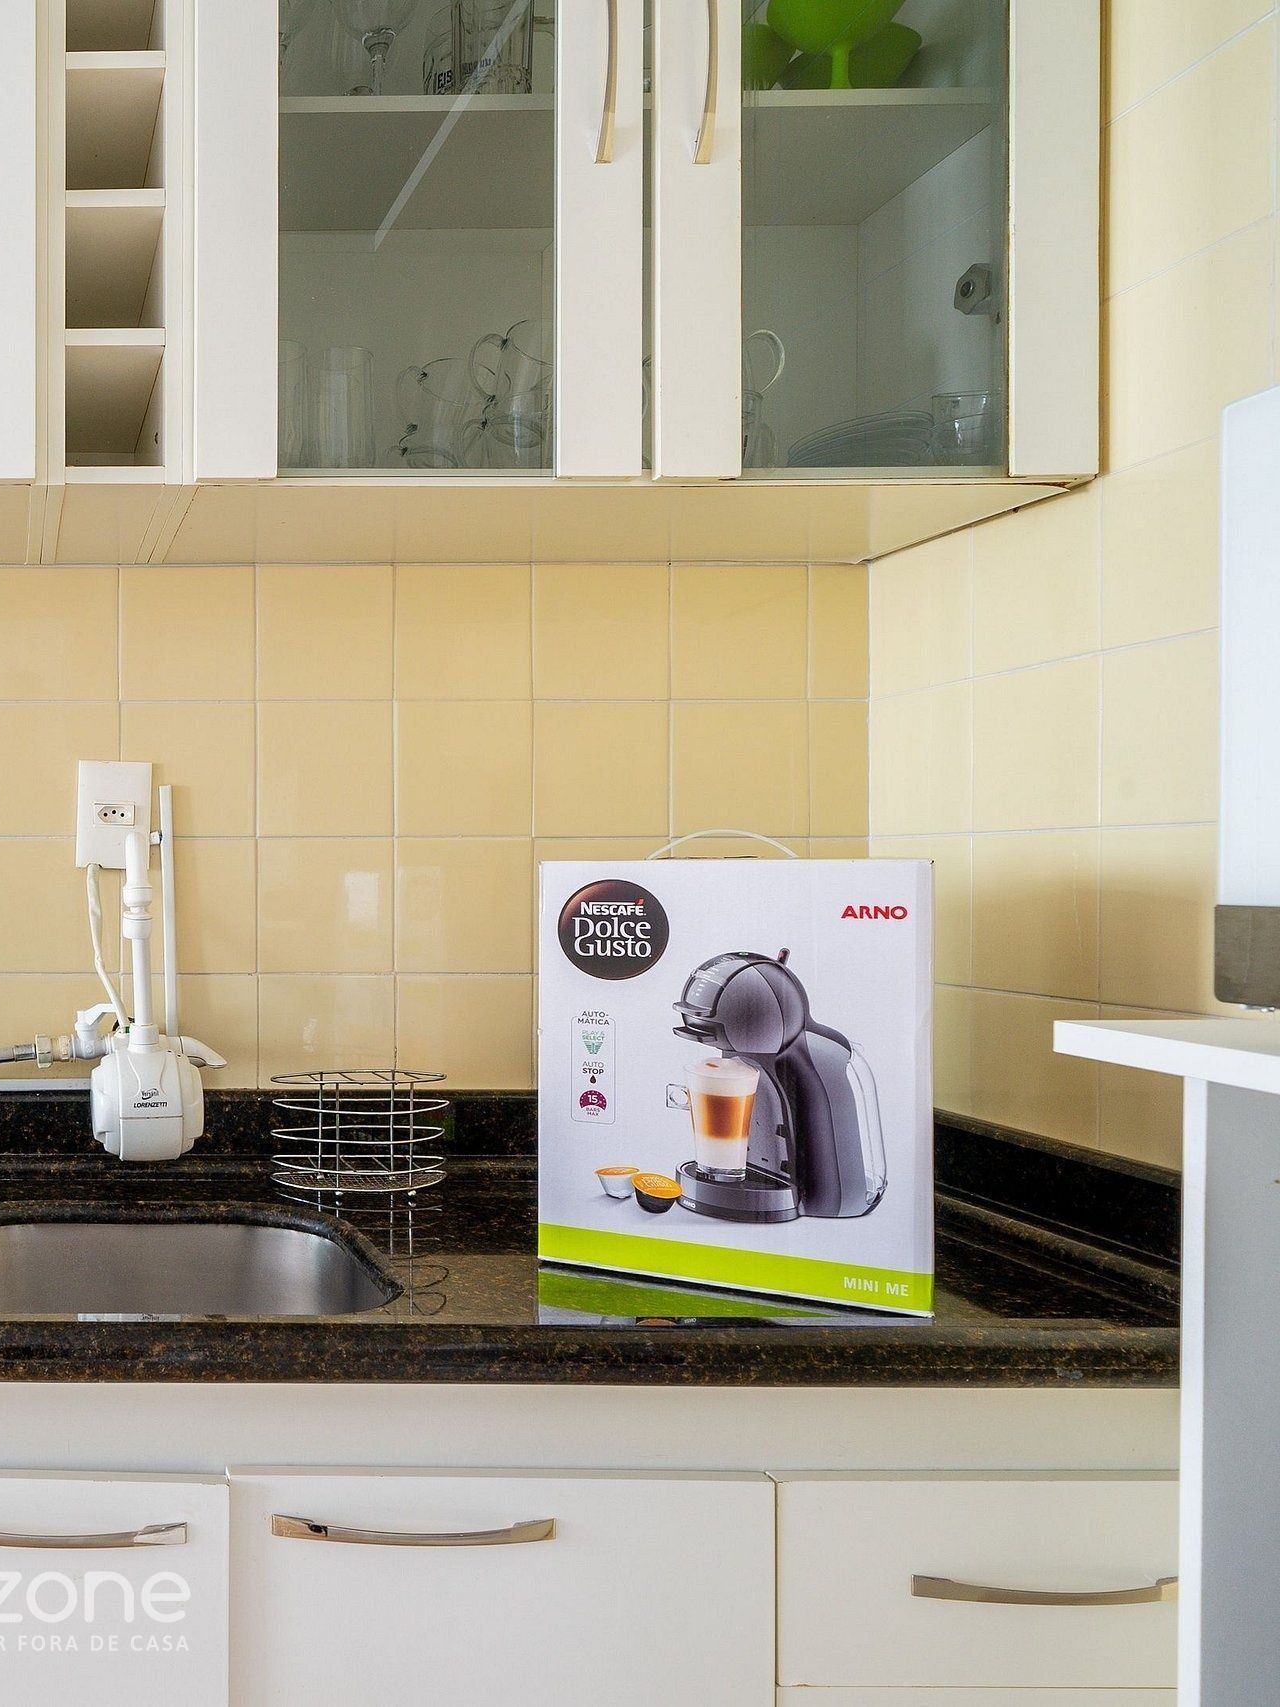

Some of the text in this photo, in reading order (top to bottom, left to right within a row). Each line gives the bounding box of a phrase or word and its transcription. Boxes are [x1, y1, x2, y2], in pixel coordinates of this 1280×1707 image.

[841, 905, 908, 920] ARNO
[572, 916, 652, 939] Dolce
[574, 935, 652, 958] Gusto
[581, 1010, 610, 1018] AUTO-
[582, 1067, 605, 1075] STOP
[587, 1094, 598, 1103] 15
[133, 1101, 168, 1109] LORENZETTI
[843, 1276, 909, 1297] MINI ME
